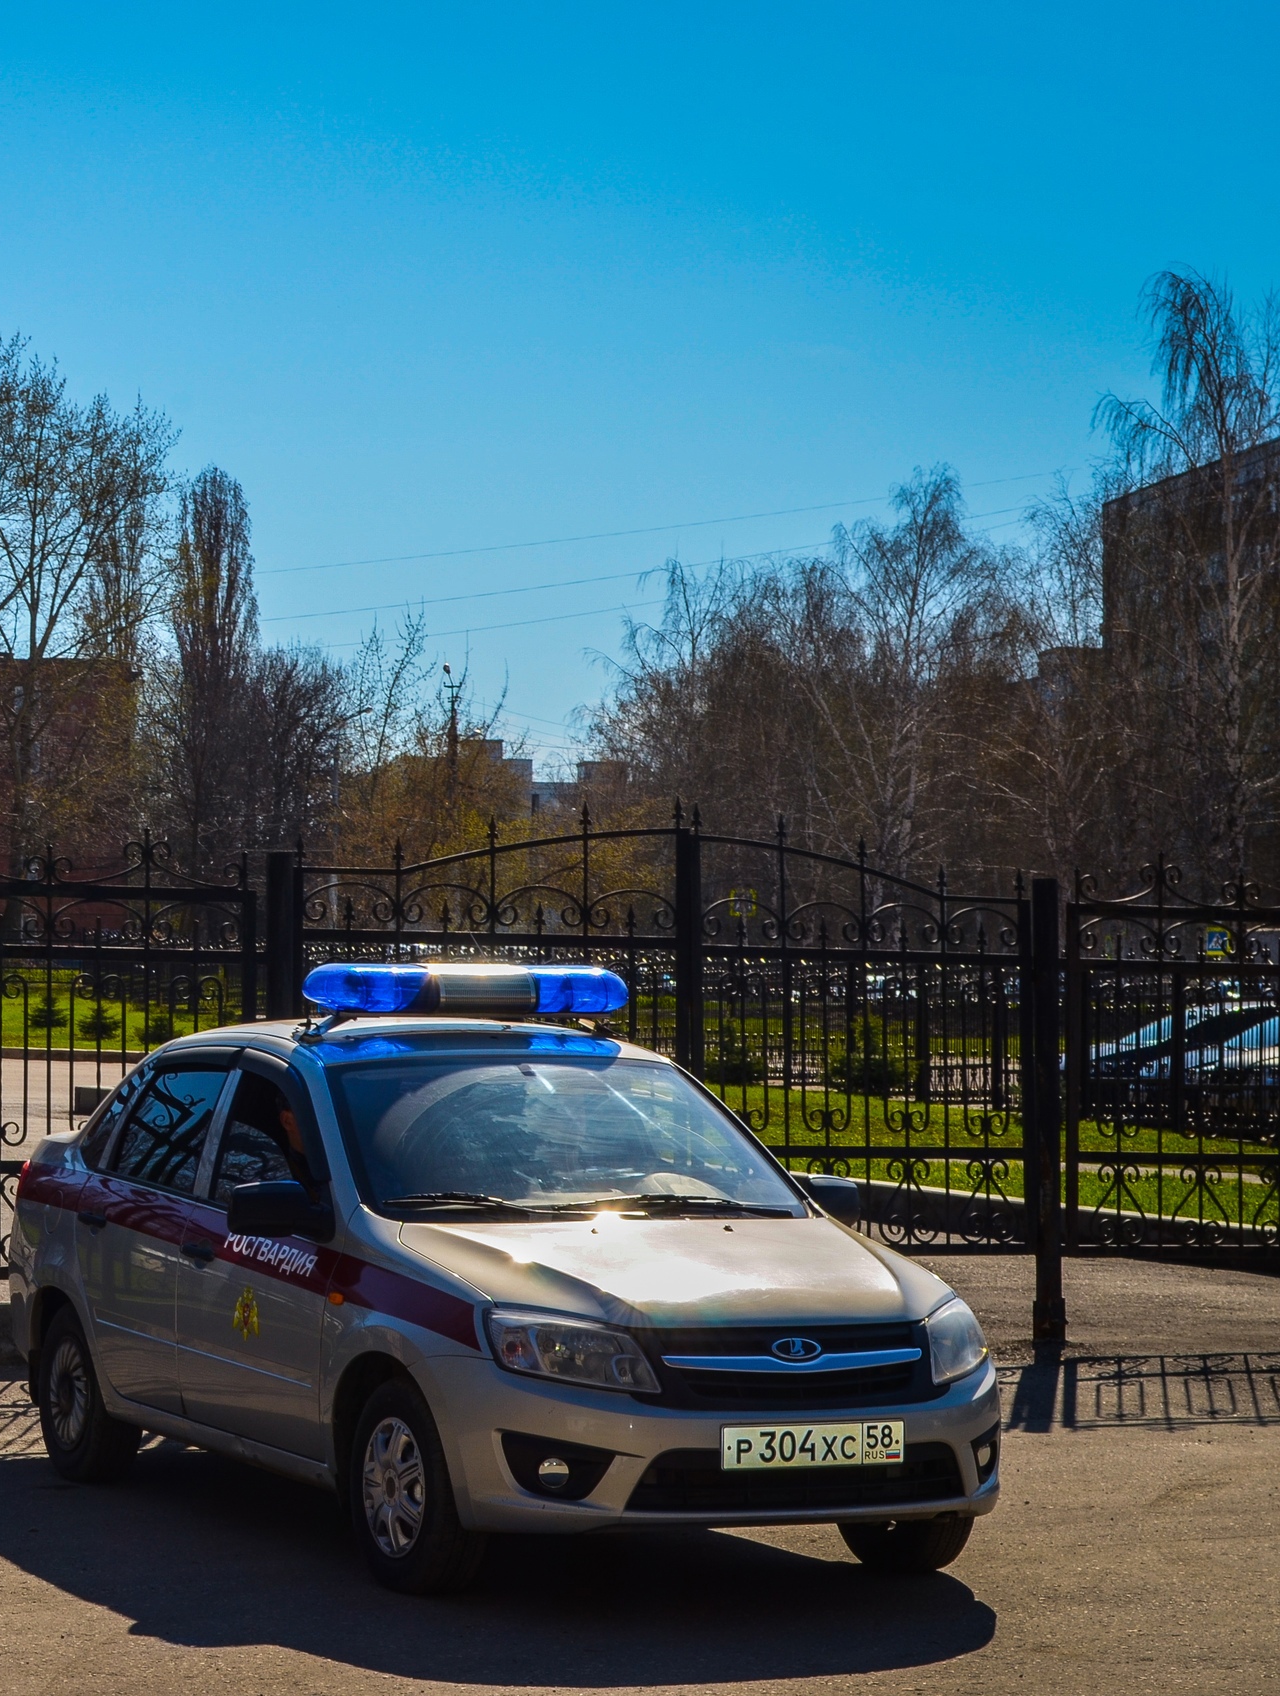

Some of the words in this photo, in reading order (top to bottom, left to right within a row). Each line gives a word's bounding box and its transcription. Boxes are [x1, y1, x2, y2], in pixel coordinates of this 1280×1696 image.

[224, 1232, 318, 1277] РОСГВАРДИЯ
[866, 1424, 894, 1449] 58
[865, 1450, 885, 1460] RUS
